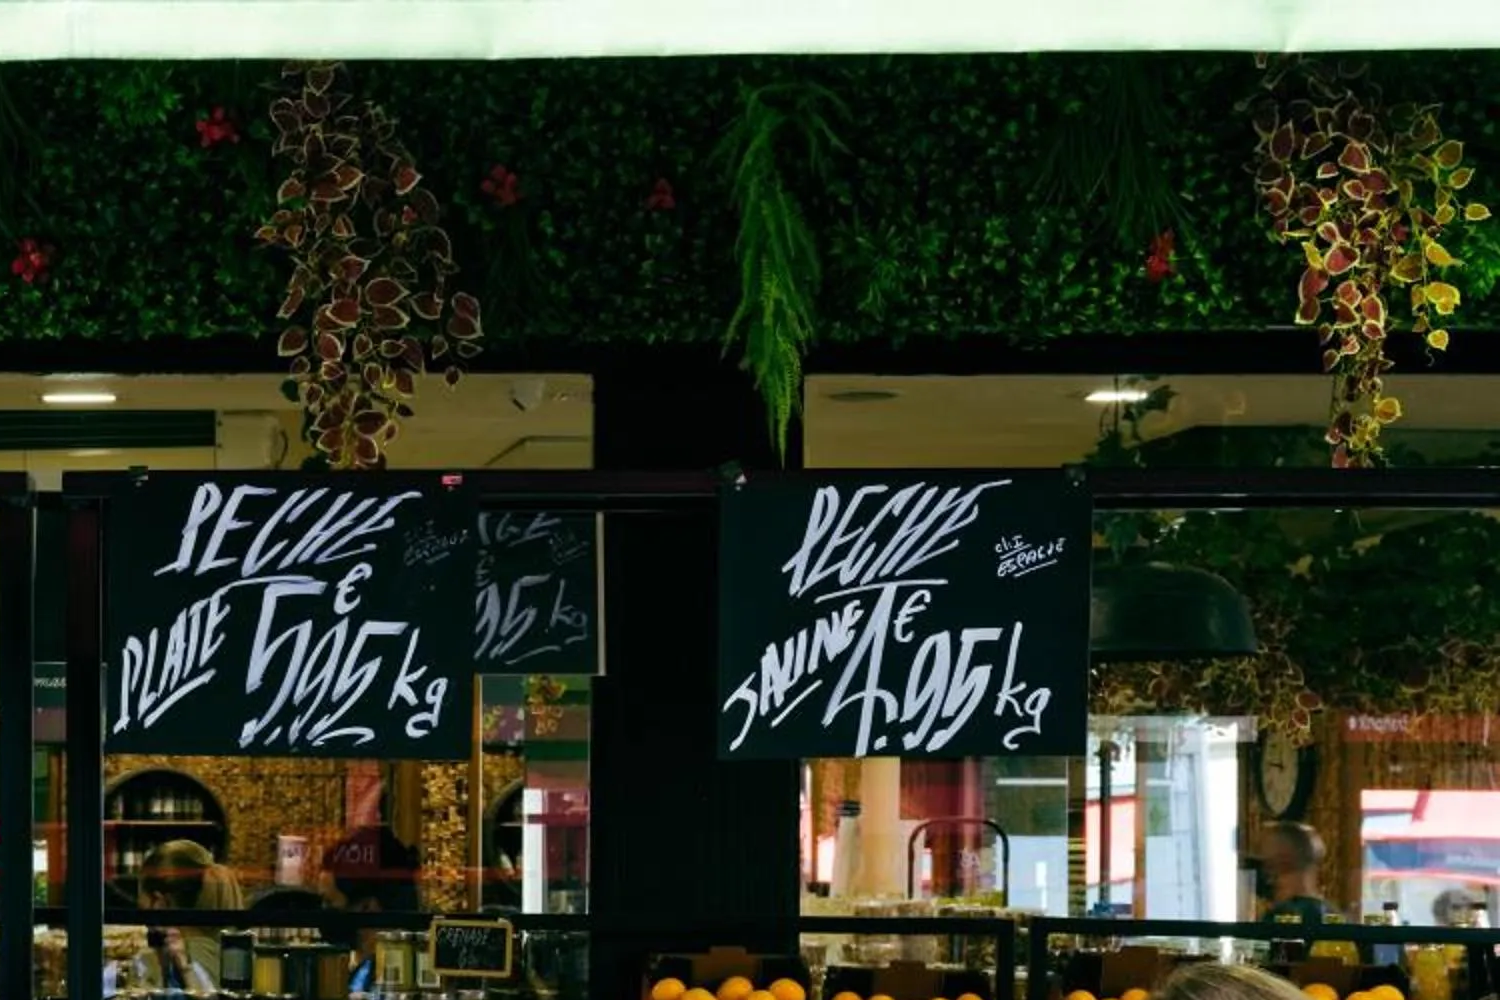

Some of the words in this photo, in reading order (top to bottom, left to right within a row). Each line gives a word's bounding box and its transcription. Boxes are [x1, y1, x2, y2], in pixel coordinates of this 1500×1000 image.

[153, 482, 422, 577] PECHE
[782, 479, 1012, 598] PECHE
[113, 590, 231, 735] PLATE
[388, 627, 449, 739] kg
[994, 621, 1052, 751] kg
